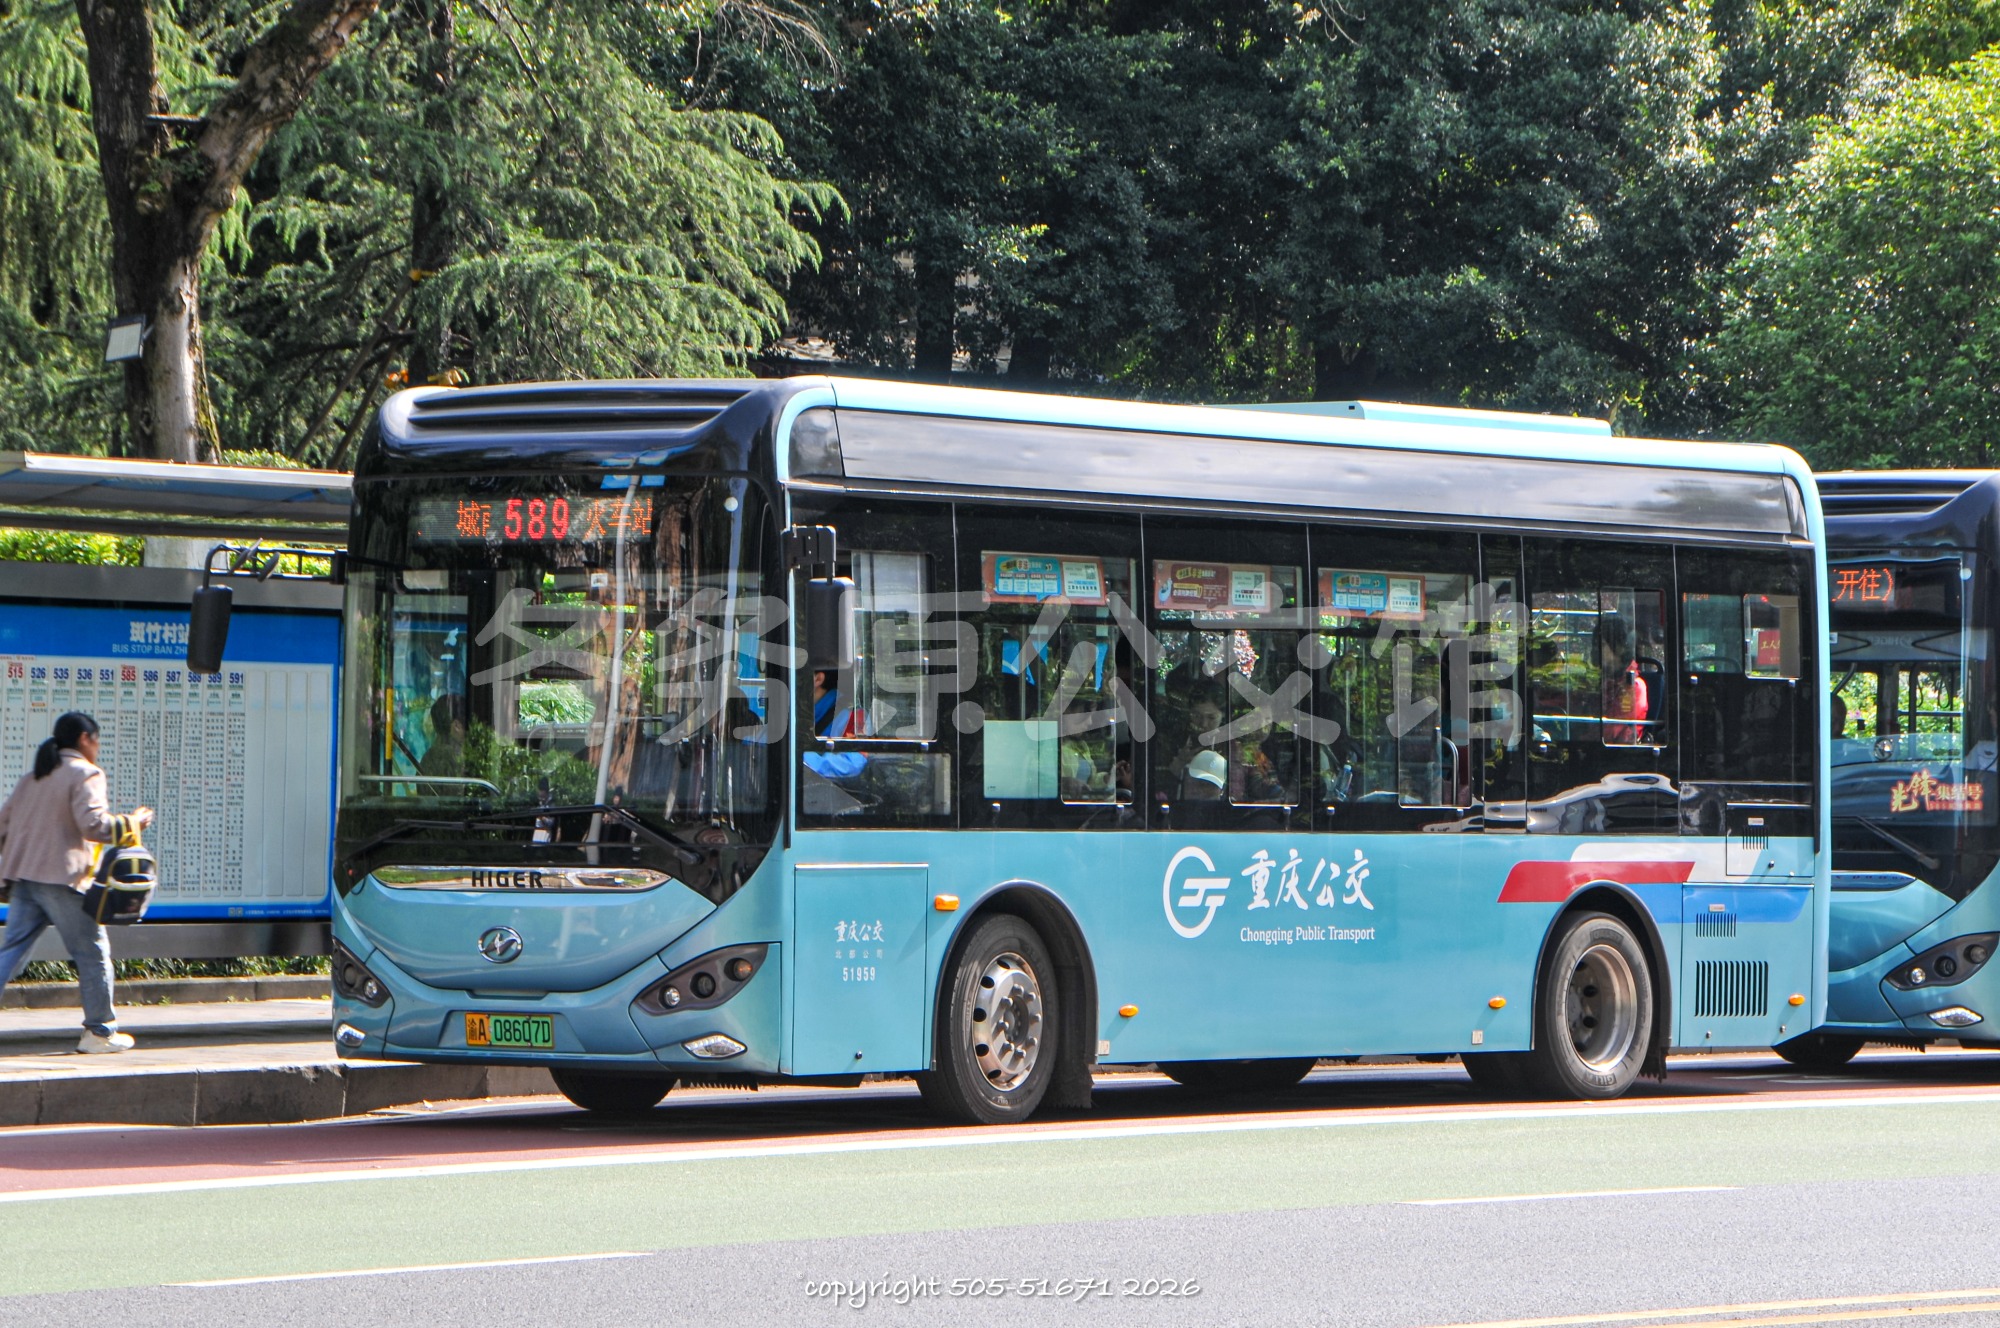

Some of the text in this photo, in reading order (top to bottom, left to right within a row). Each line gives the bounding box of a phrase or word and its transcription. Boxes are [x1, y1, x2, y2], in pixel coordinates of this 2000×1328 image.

[504, 498, 569, 540] 589
[584, 497, 653, 539] 火车站
[112, 643, 188, 655] BUS STOP BAN ZH
[1760, 639, 1780, 650] 工人
[8, 666, 23, 679] 515
[30, 667, 46, 679] 526
[53, 668, 69, 680] 535
[77, 668, 93, 680] 536
[100, 669, 114, 681] 551
[121, 669, 136, 681] 585
[143, 670, 159, 682] 586
[166, 670, 181, 682] 587
[229, 672, 244, 684] 591
[472, 870, 543, 889] HIGER
[1241, 848, 1375, 911] 重庆公交
[834, 920, 885, 943] 重庆公交
[1240, 926, 1375, 945] Chongqing Public Transport
[842, 966, 876, 982] 51959
